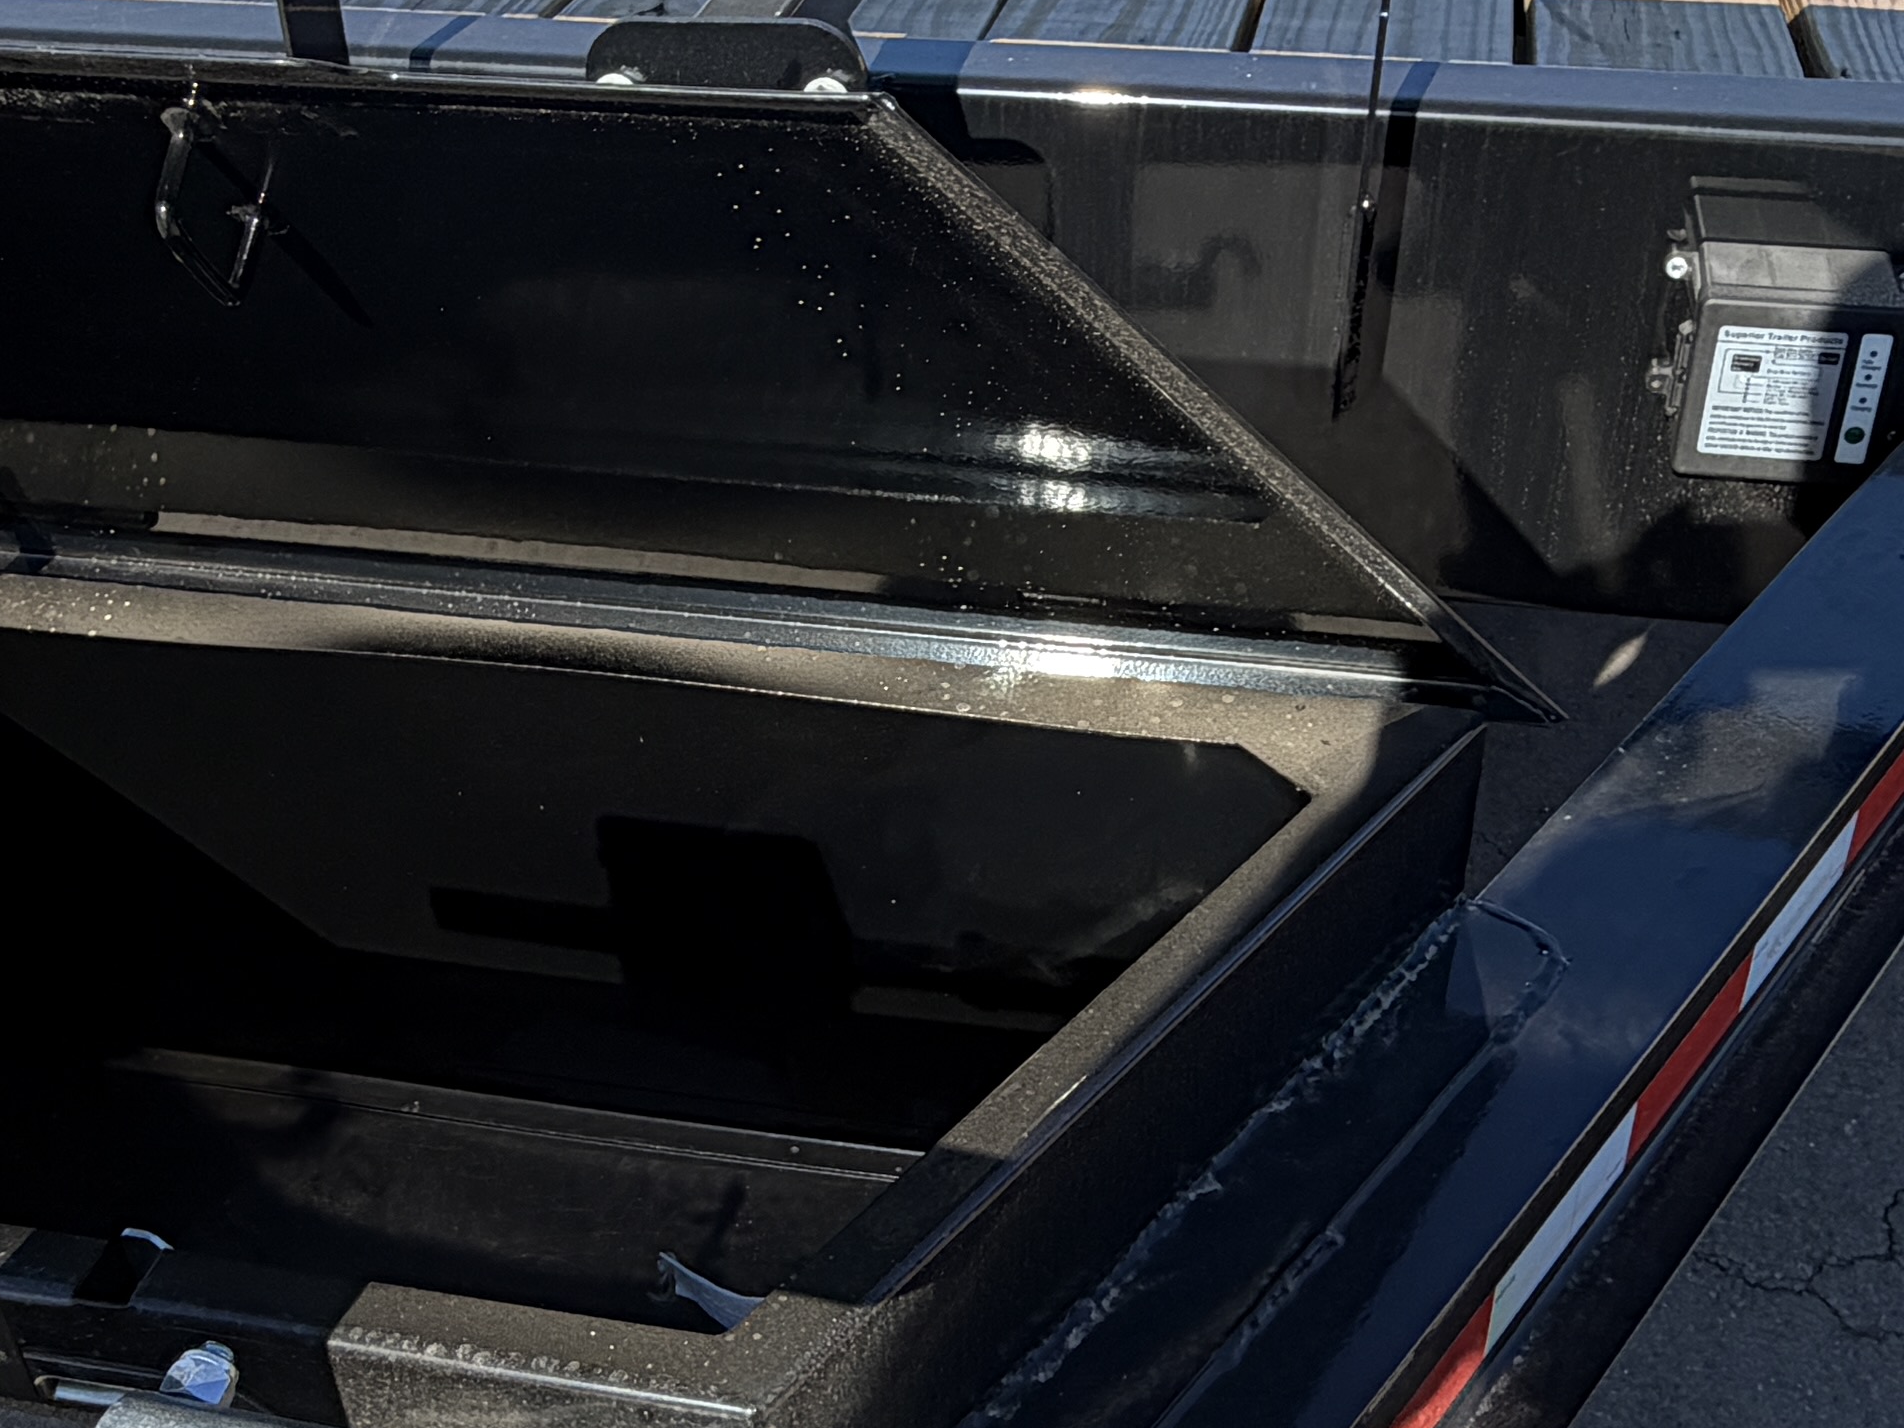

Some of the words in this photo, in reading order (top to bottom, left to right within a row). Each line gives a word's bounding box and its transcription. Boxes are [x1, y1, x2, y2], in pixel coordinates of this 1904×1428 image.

[1724, 329, 1766, 340] Superior
[1767, 332, 1799, 342] Trailer
[1799, 335, 1844, 345] Products
